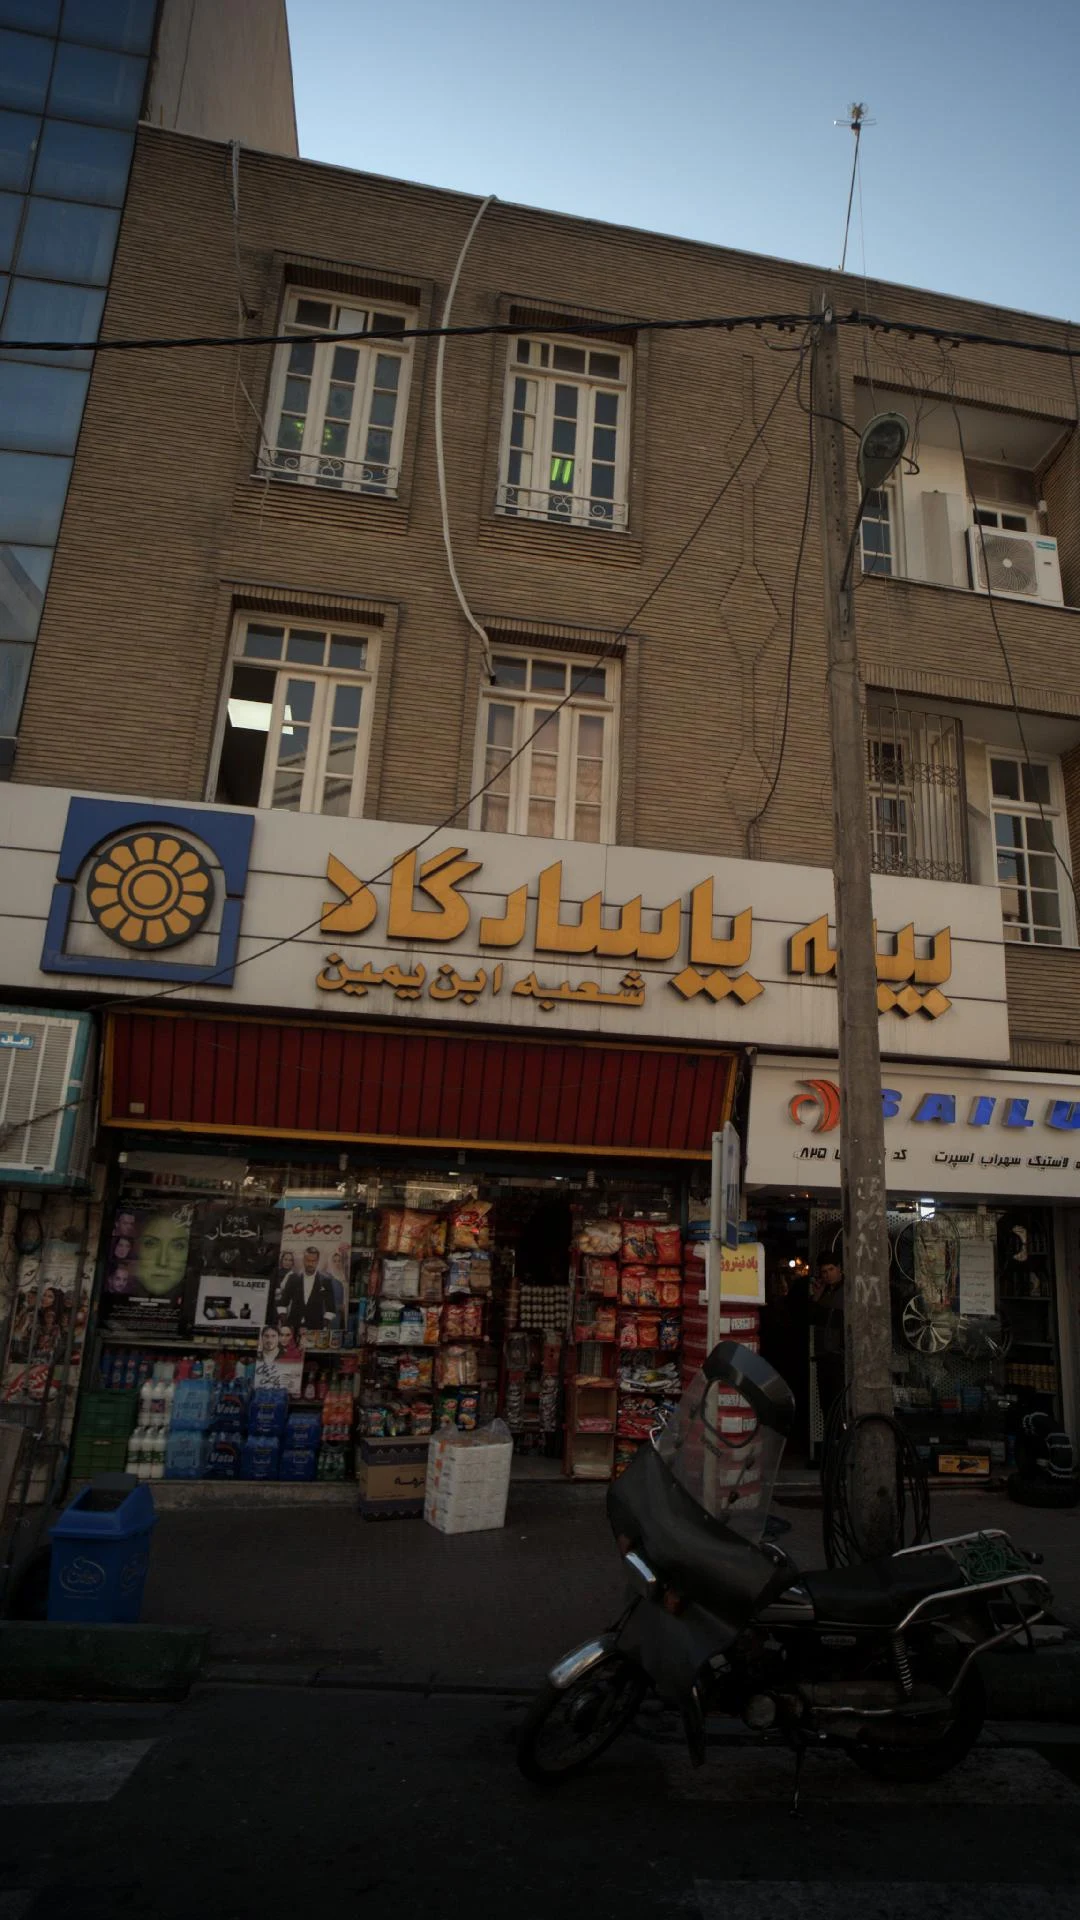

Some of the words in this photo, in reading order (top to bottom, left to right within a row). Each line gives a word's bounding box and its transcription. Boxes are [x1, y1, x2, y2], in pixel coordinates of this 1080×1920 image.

[320, 846, 765, 1005] پاسارگاد
[429, 963, 504, 1006] ابن
[788, 913, 952, 1020] بیه
[512, 969, 646, 1011] شعبه
[935, 1151, 974, 1168] اسپرت
[1028, 1155, 1069, 1170] لاستیک
